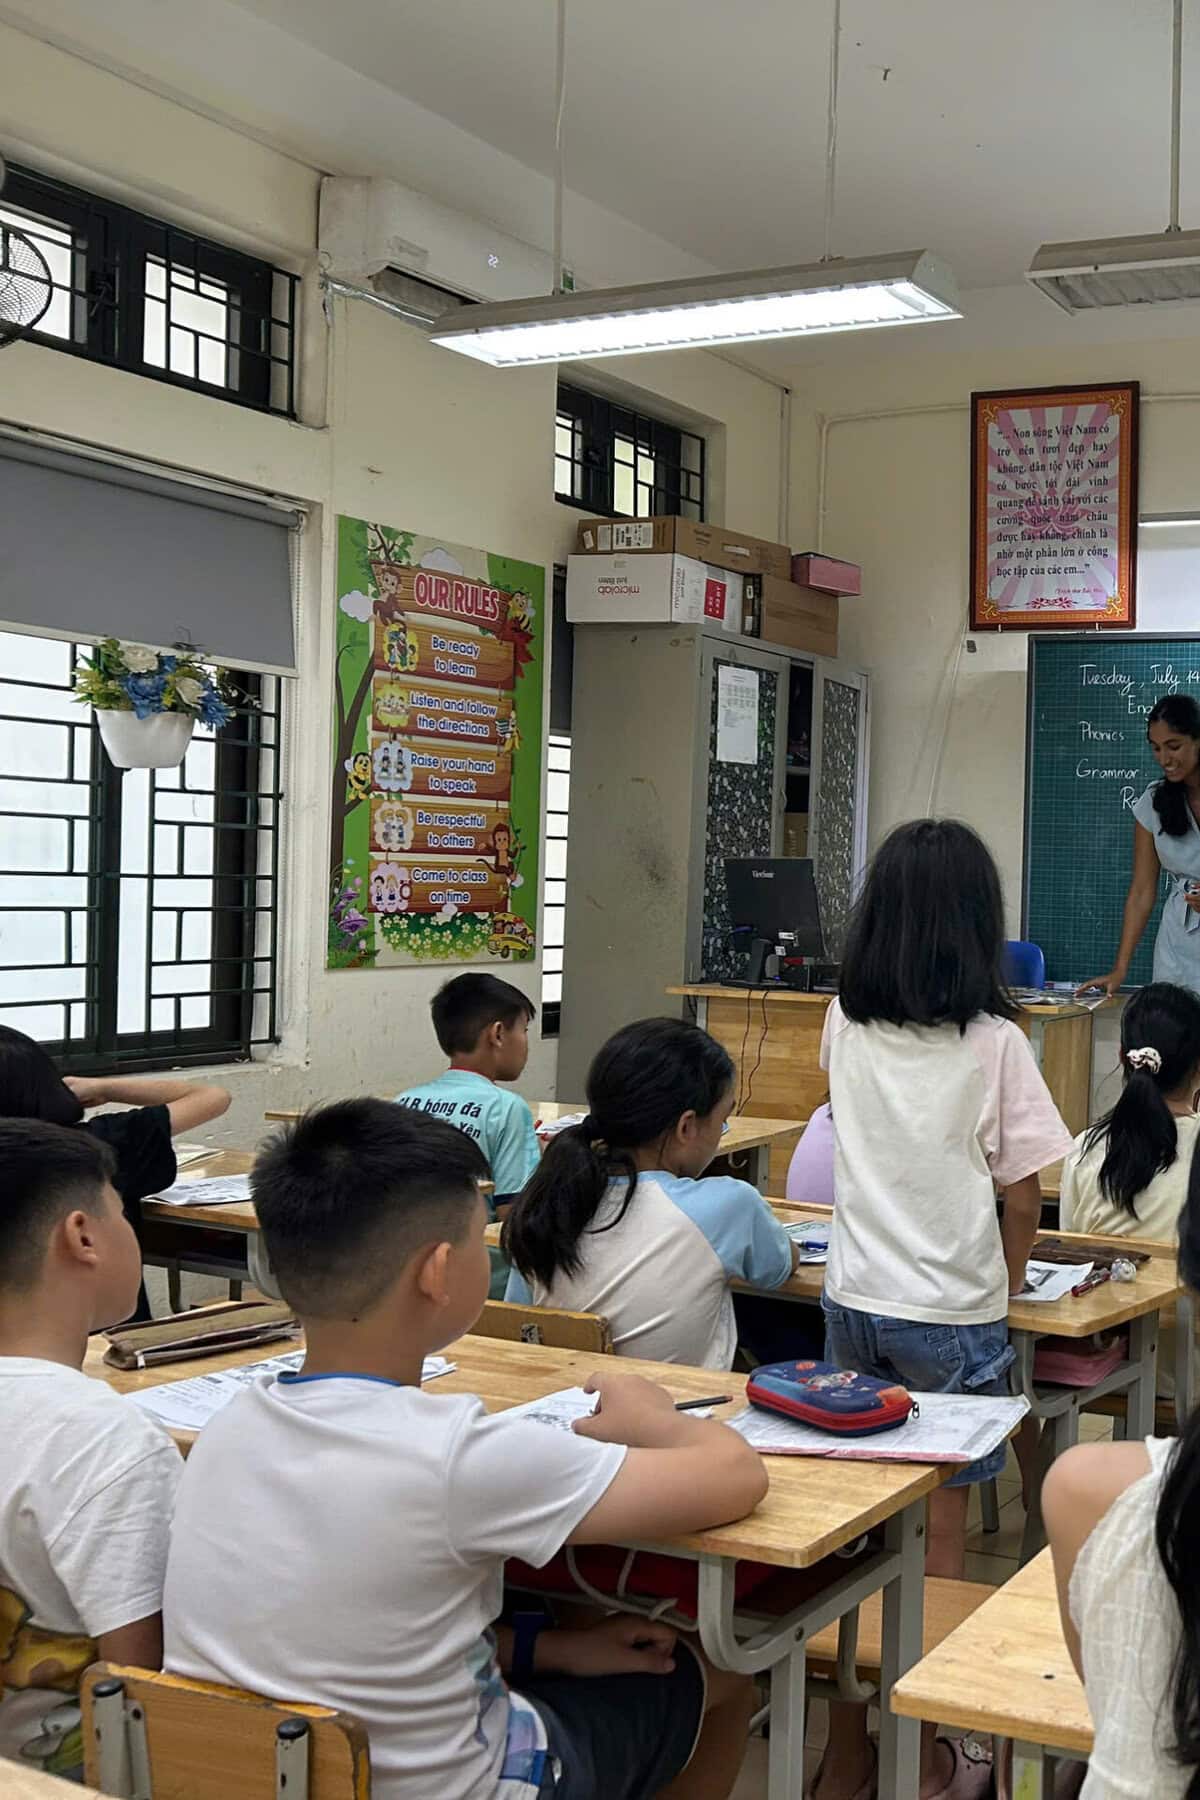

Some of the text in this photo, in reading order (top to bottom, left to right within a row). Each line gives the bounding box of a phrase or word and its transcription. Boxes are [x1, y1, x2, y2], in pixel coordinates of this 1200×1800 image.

[1014, 428, 1030, 438] Non
[1055, 425, 1073, 437] Việt
[1076, 424, 1096, 435] Nam
[1093, 441, 1108, 453] hay
[1066, 459, 1084, 472] Việt
[1088, 459, 1109, 469] Nam
[1089, 476, 1108, 486] vinh
[997, 499, 1024, 510] quang
[1016, 549, 1033, 560] một
[997, 566, 1012, 578] học
[1048, 564, 1061, 574] các
[415, 573, 499, 620] OUR RULES
[597, 584, 640, 596] microlab
[432, 636, 479, 659] Be ready
[435, 658, 476, 676] to learn
[1150, 664, 1182, 694] July
[410, 693, 497, 716] Listen and follow
[418, 715, 489, 736] the directions
[1078, 720, 1125, 742] Phonics
[411, 754, 495, 774] Raise your hand
[1076, 758, 1140, 779] Grammar
[429, 775, 476, 794] to speak
[417, 811, 486, 829] Be respectful
[428, 832, 474, 848] to others
[412, 868, 488, 883] Come to class
[430, 890, 470, 903] on time
[424, 1097, 458, 1116] bóng
[460, 1101, 484, 1118] đá
[459, 1121, 482, 1140] Yên
